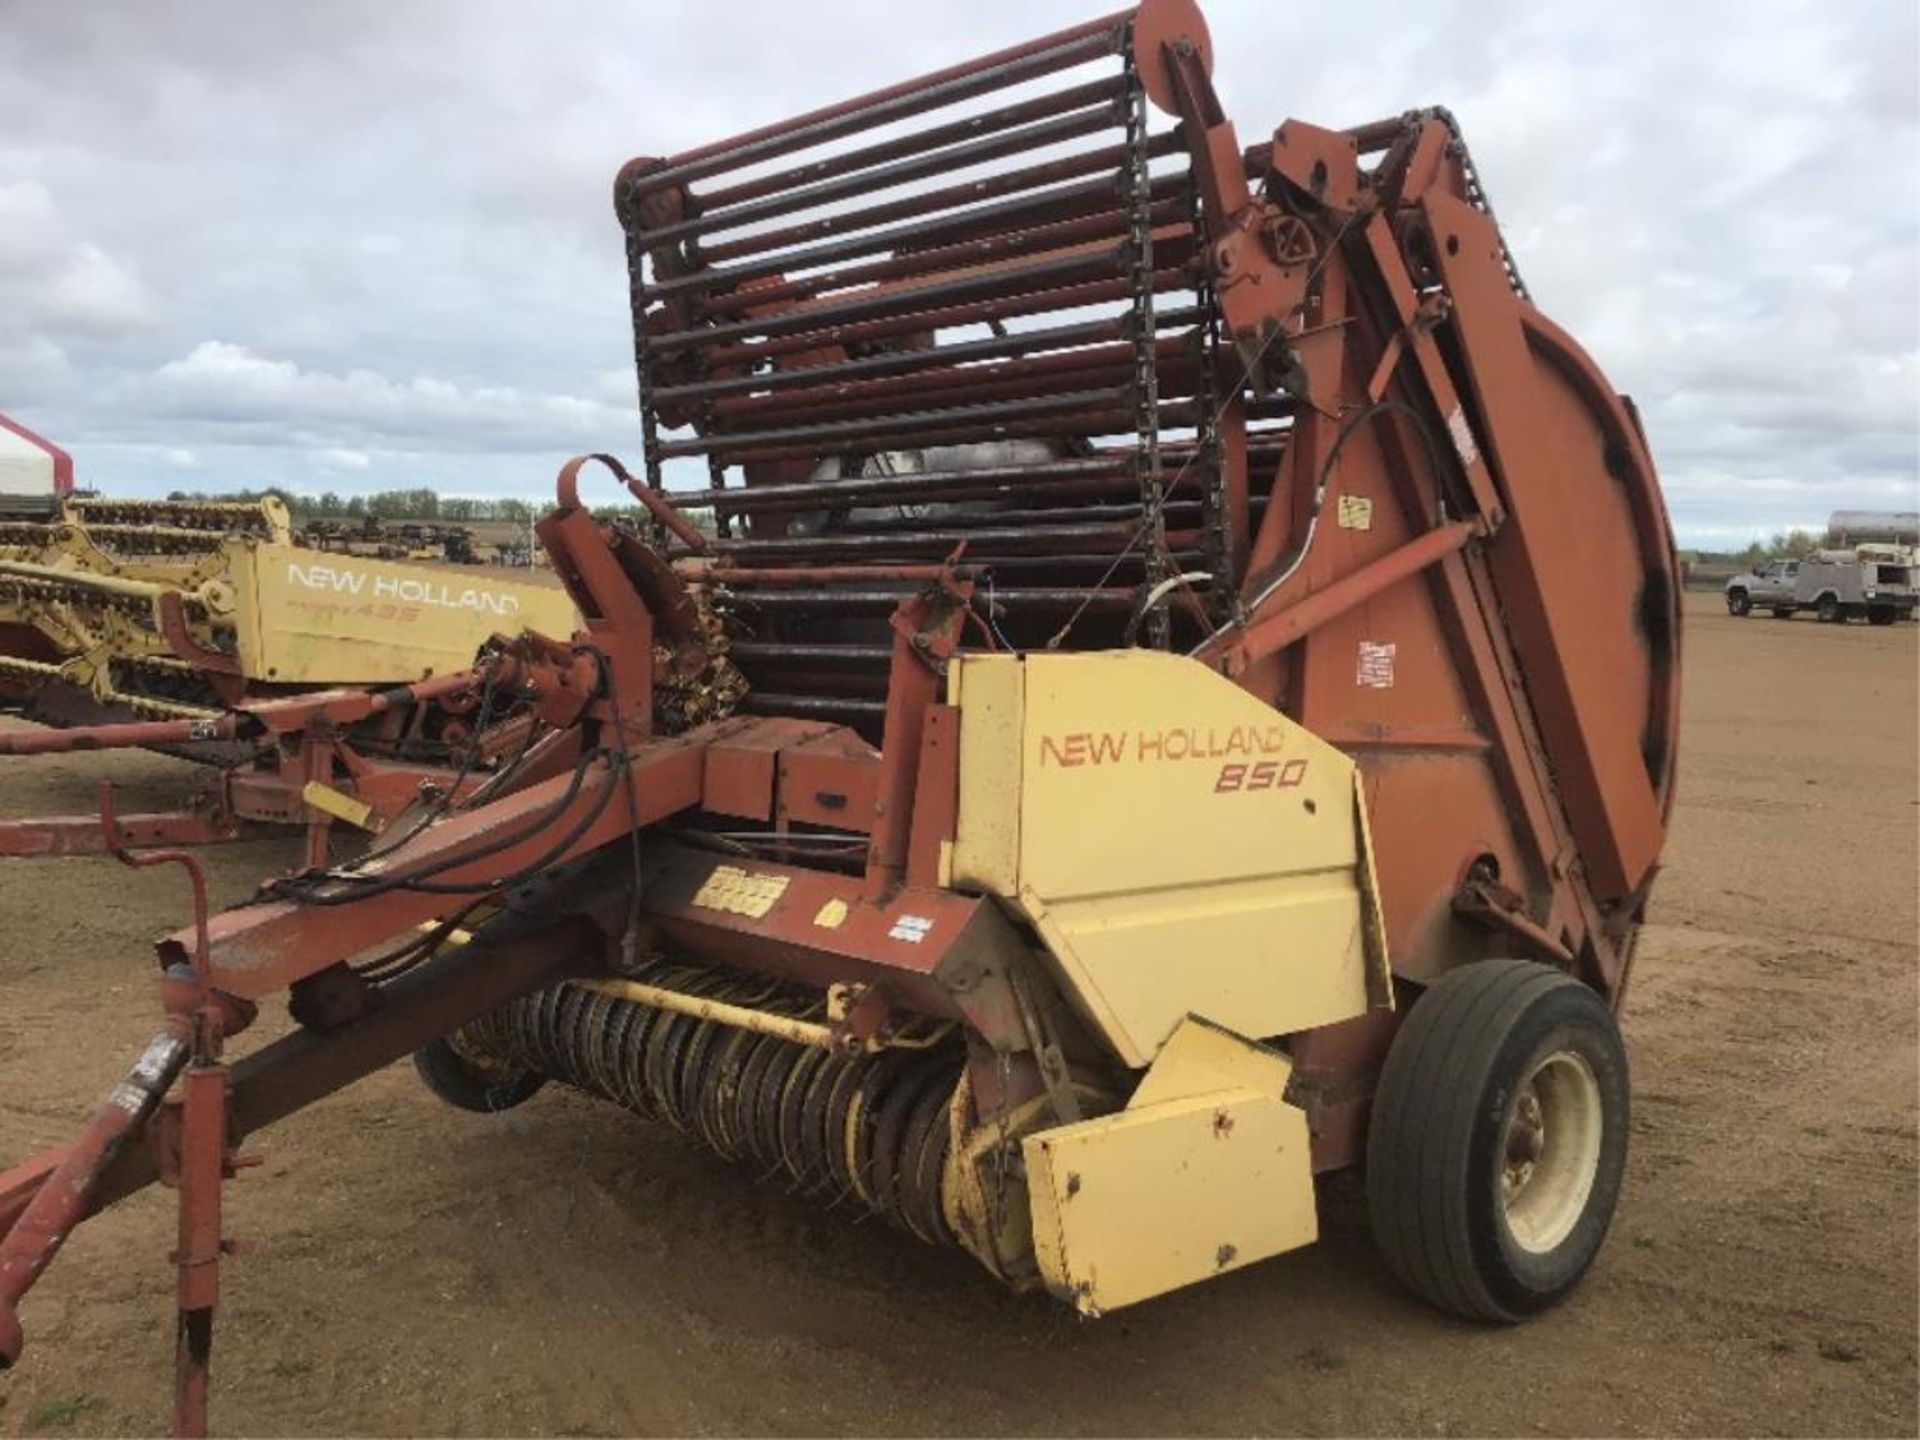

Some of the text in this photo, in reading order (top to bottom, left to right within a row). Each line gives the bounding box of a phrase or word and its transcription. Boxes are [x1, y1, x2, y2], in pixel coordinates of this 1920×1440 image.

[287, 563, 367, 595] NEW
[374, 577, 519, 616] HOLLAND
[1040, 726, 1285, 768] NEW HOLLAND
[1214, 760, 1309, 794] 850
